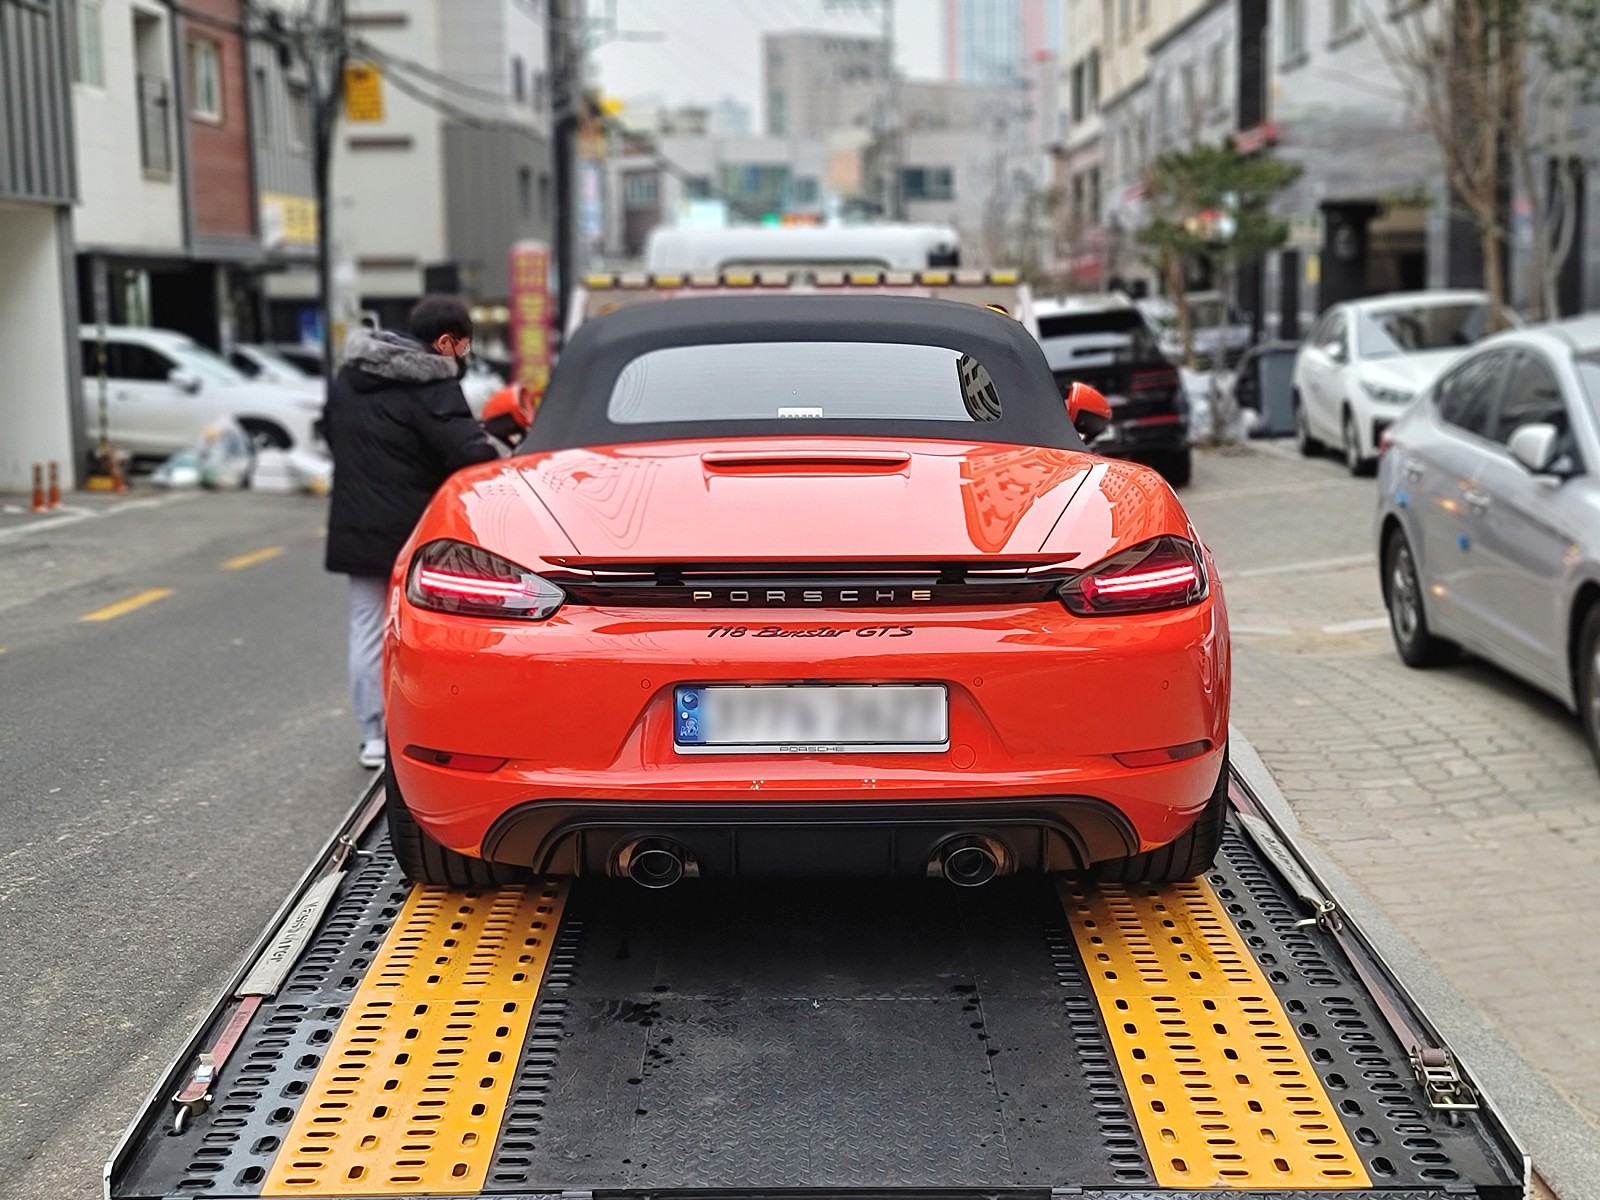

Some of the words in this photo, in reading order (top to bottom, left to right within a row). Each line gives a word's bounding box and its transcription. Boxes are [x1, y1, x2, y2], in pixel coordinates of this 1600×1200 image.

[693, 590, 931, 602] PORSCHE
[707, 625, 748, 638] 718
[751, 626, 850, 638] Boxster
[855, 625, 915, 638] GTS
